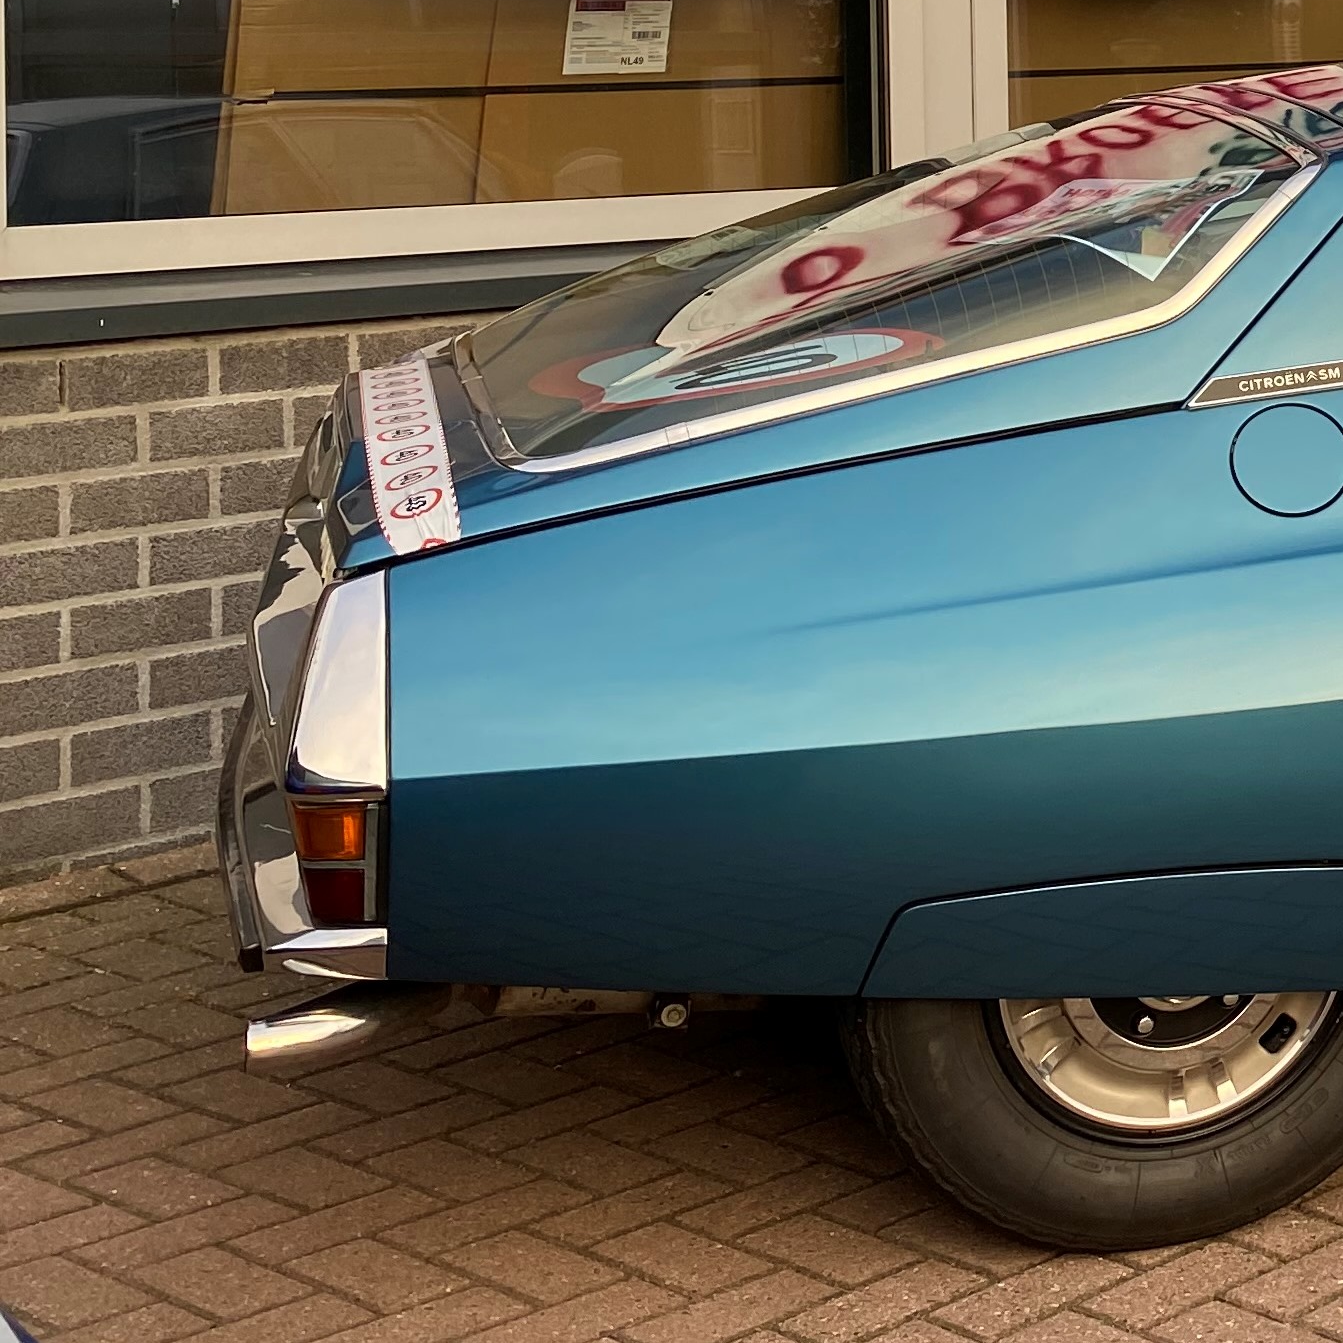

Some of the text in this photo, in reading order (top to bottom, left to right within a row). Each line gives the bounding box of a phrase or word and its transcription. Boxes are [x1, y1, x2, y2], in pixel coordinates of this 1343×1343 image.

[620, 57, 644, 66] NL49
[1238, 367, 1341, 392] CITROËN SM
